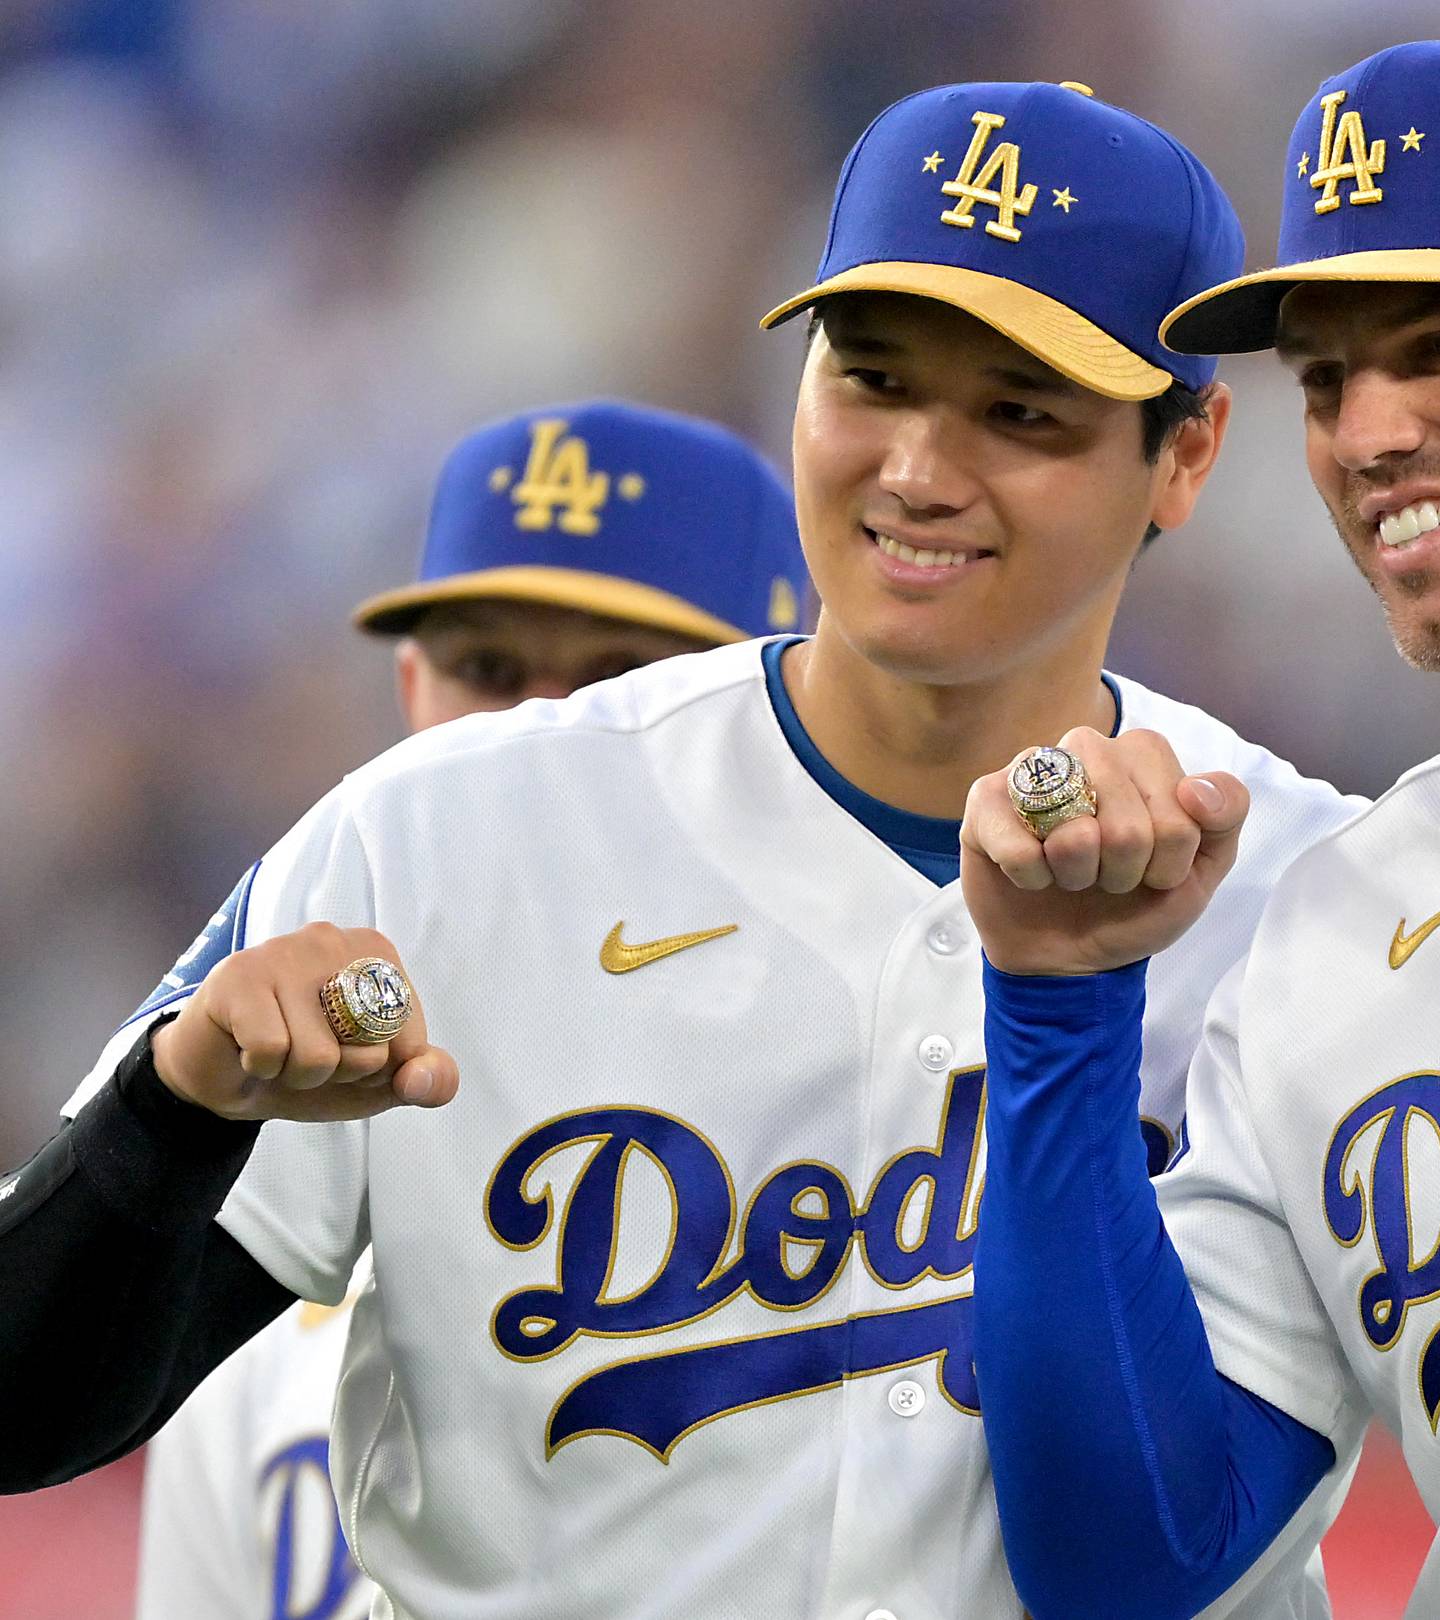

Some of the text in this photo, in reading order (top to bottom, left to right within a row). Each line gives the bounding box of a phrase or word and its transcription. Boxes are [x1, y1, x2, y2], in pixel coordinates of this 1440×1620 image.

[939, 110, 1039, 243] LA
[1310, 89, 1387, 215] LA
[512, 420, 609, 535] LA
